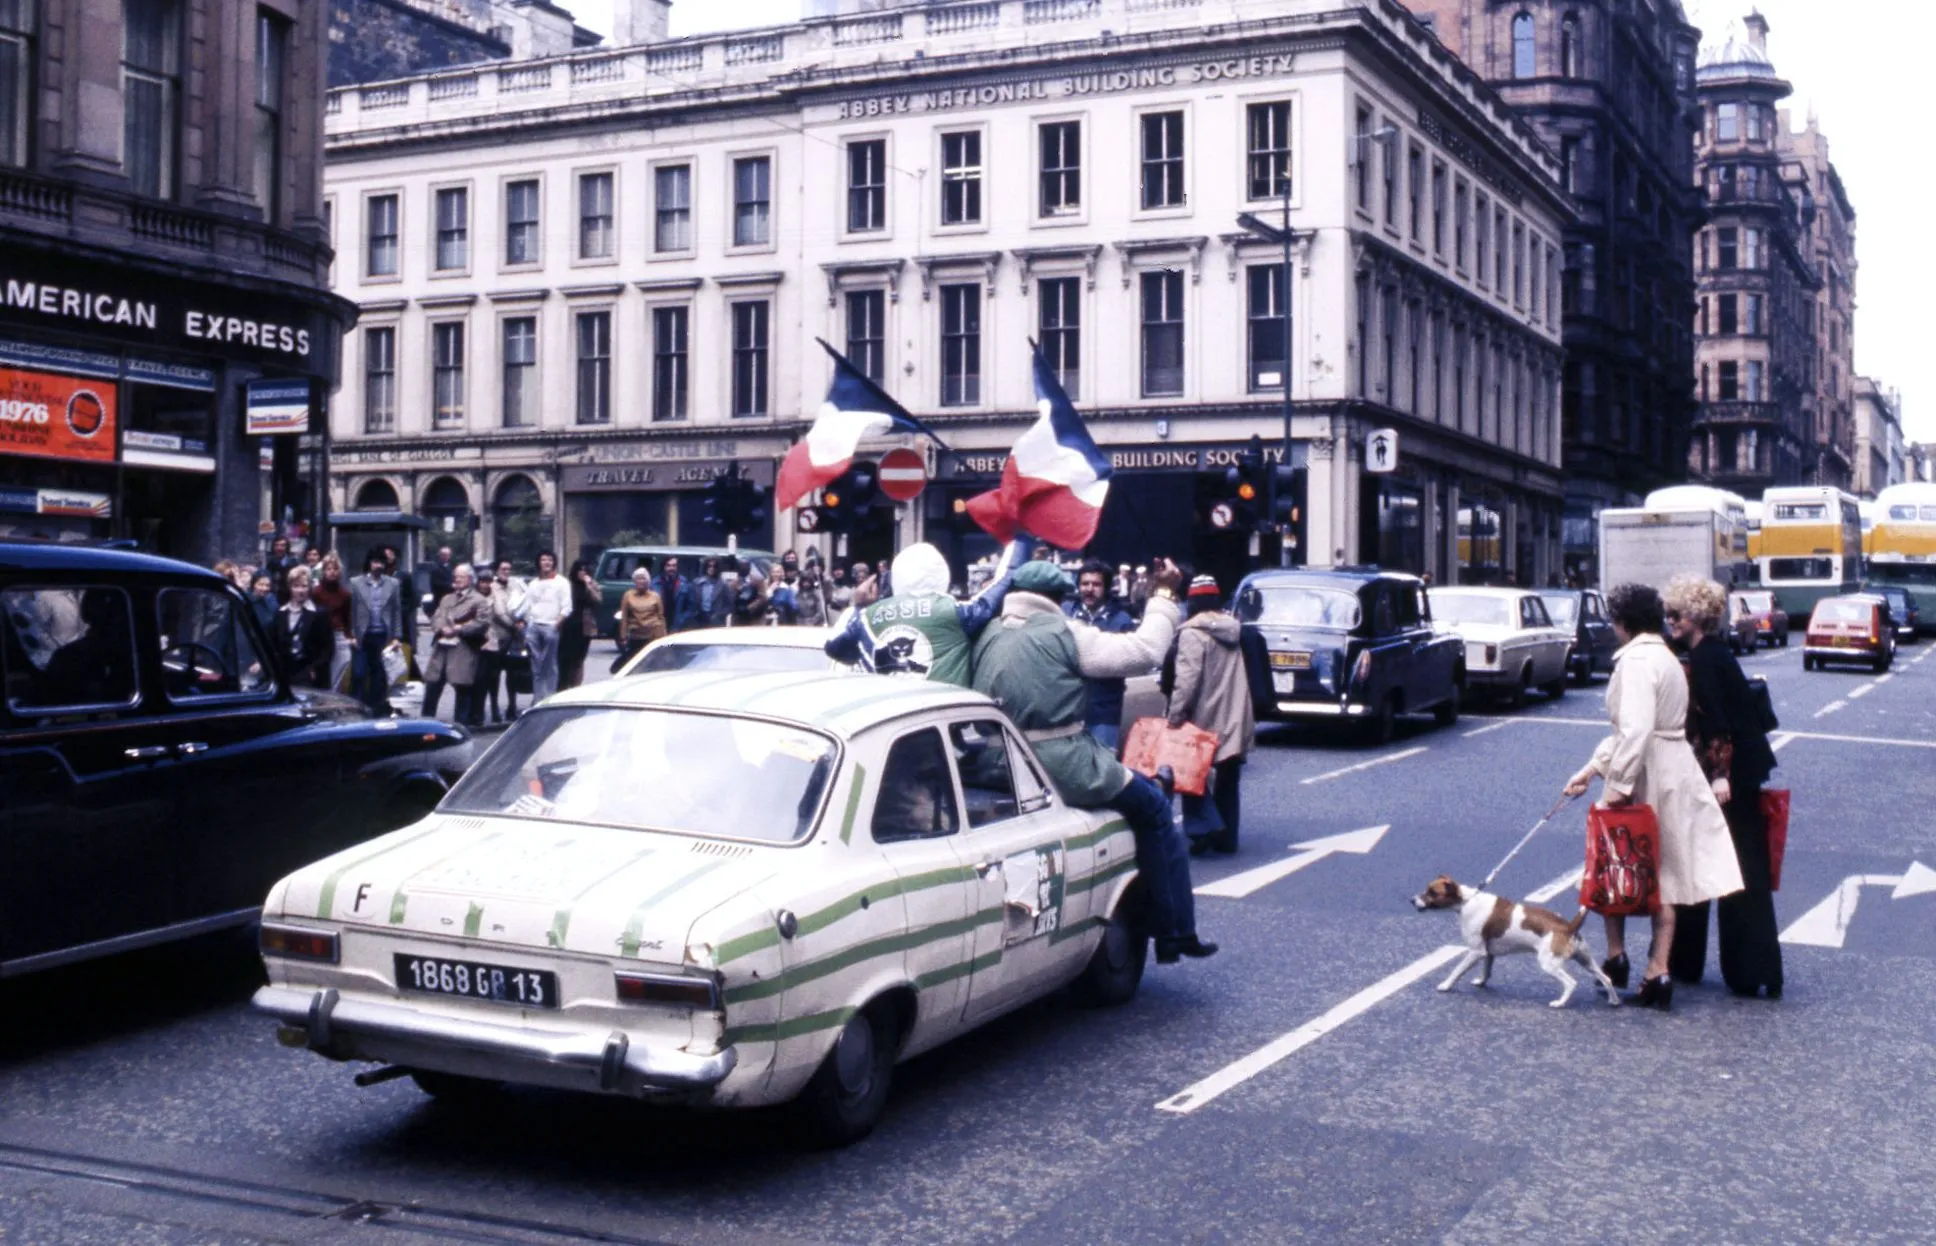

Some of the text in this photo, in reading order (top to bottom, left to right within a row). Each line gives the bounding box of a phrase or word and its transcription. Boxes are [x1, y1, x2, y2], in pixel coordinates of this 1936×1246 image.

[838, 54, 1296, 120] ABBEY NATIONAL BUILDING SOCIETY
[0, 279, 311, 355] MERICAN EXPRESS
[0, 399, 49, 424] 1976
[1112, 449, 1198, 469] BUILDING
[1205, 447, 1284, 467] SOCTY
[587, 465, 750, 485] TRAVEL AGENY
[871, 598, 932, 625] ASSE
[353, 882, 372, 913] F
[410, 960, 470, 994] 1868
[512, 973, 543, 1004] 13
